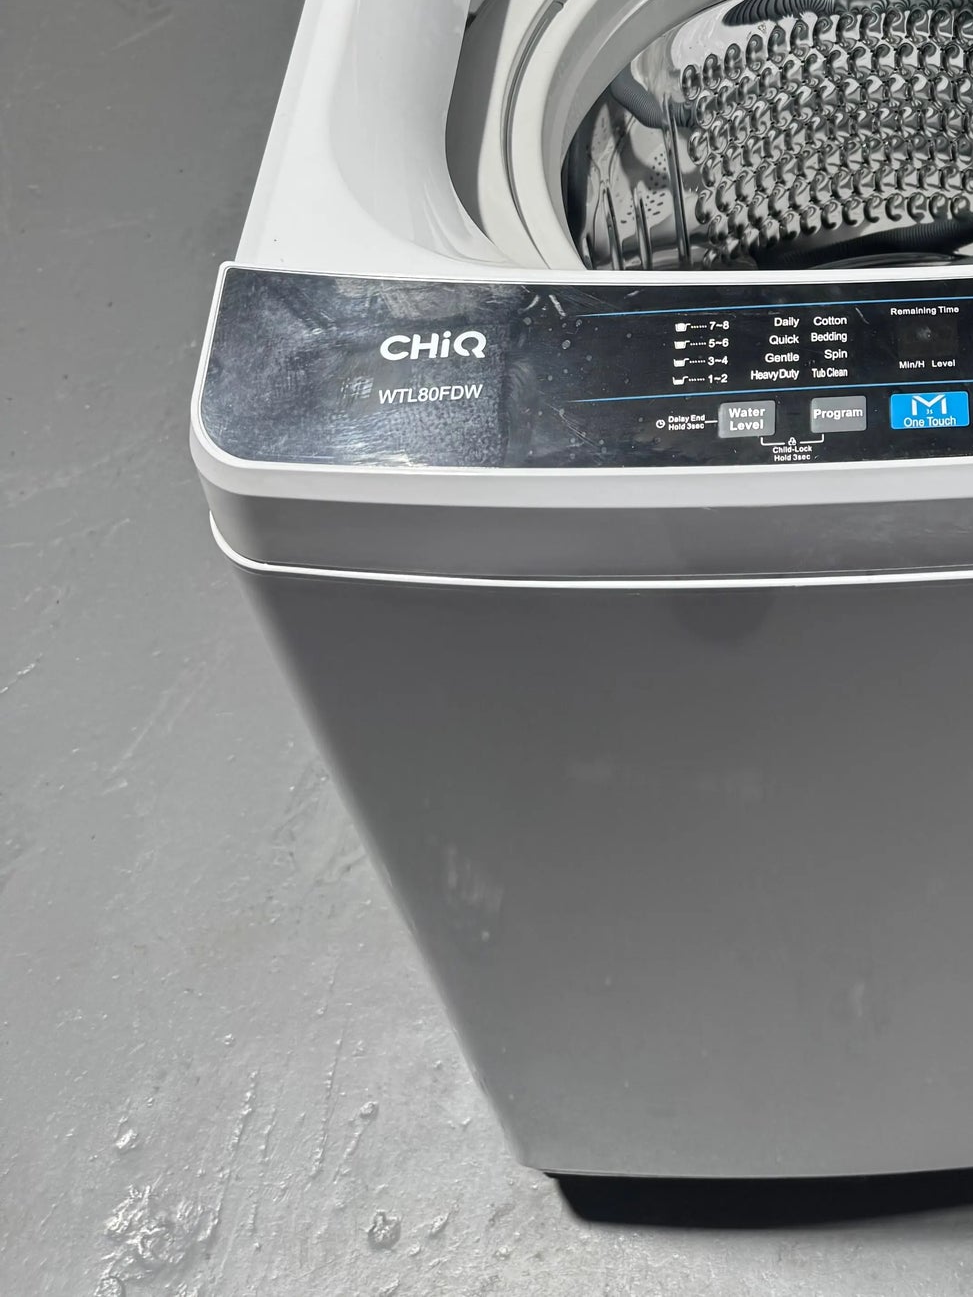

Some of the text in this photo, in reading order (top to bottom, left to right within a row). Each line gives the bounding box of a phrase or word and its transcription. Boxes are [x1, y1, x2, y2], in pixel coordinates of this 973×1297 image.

[891, 306, 959, 316] Remaining Time
[709, 322, 729, 330] 7~8
[774, 317, 800, 327] Daily
[814, 317, 847, 325] Cotton
[769, 335, 799, 345] Quick
[811, 332, 847, 342] Bedding
[379, 330, 487, 361] CHiQ
[708, 339, 729, 347] 5~6
[765, 354, 800, 363] Gentle
[824, 350, 848, 360] Spin
[708, 357, 728, 365] 3~4
[900, 359, 956, 369] Min/H Level
[812, 368, 848, 378] Tub Clean
[708, 375, 728, 383] 1~2
[378, 384, 483, 405] WTL80FDW
[729, 408, 765, 418] Water
[814, 409, 863, 421] Program
[668, 416, 689, 424] Delay
[730, 419, 764, 431] Level
[904, 416, 956, 427] One Touch
[772, 445, 812, 453] Child-Lock
